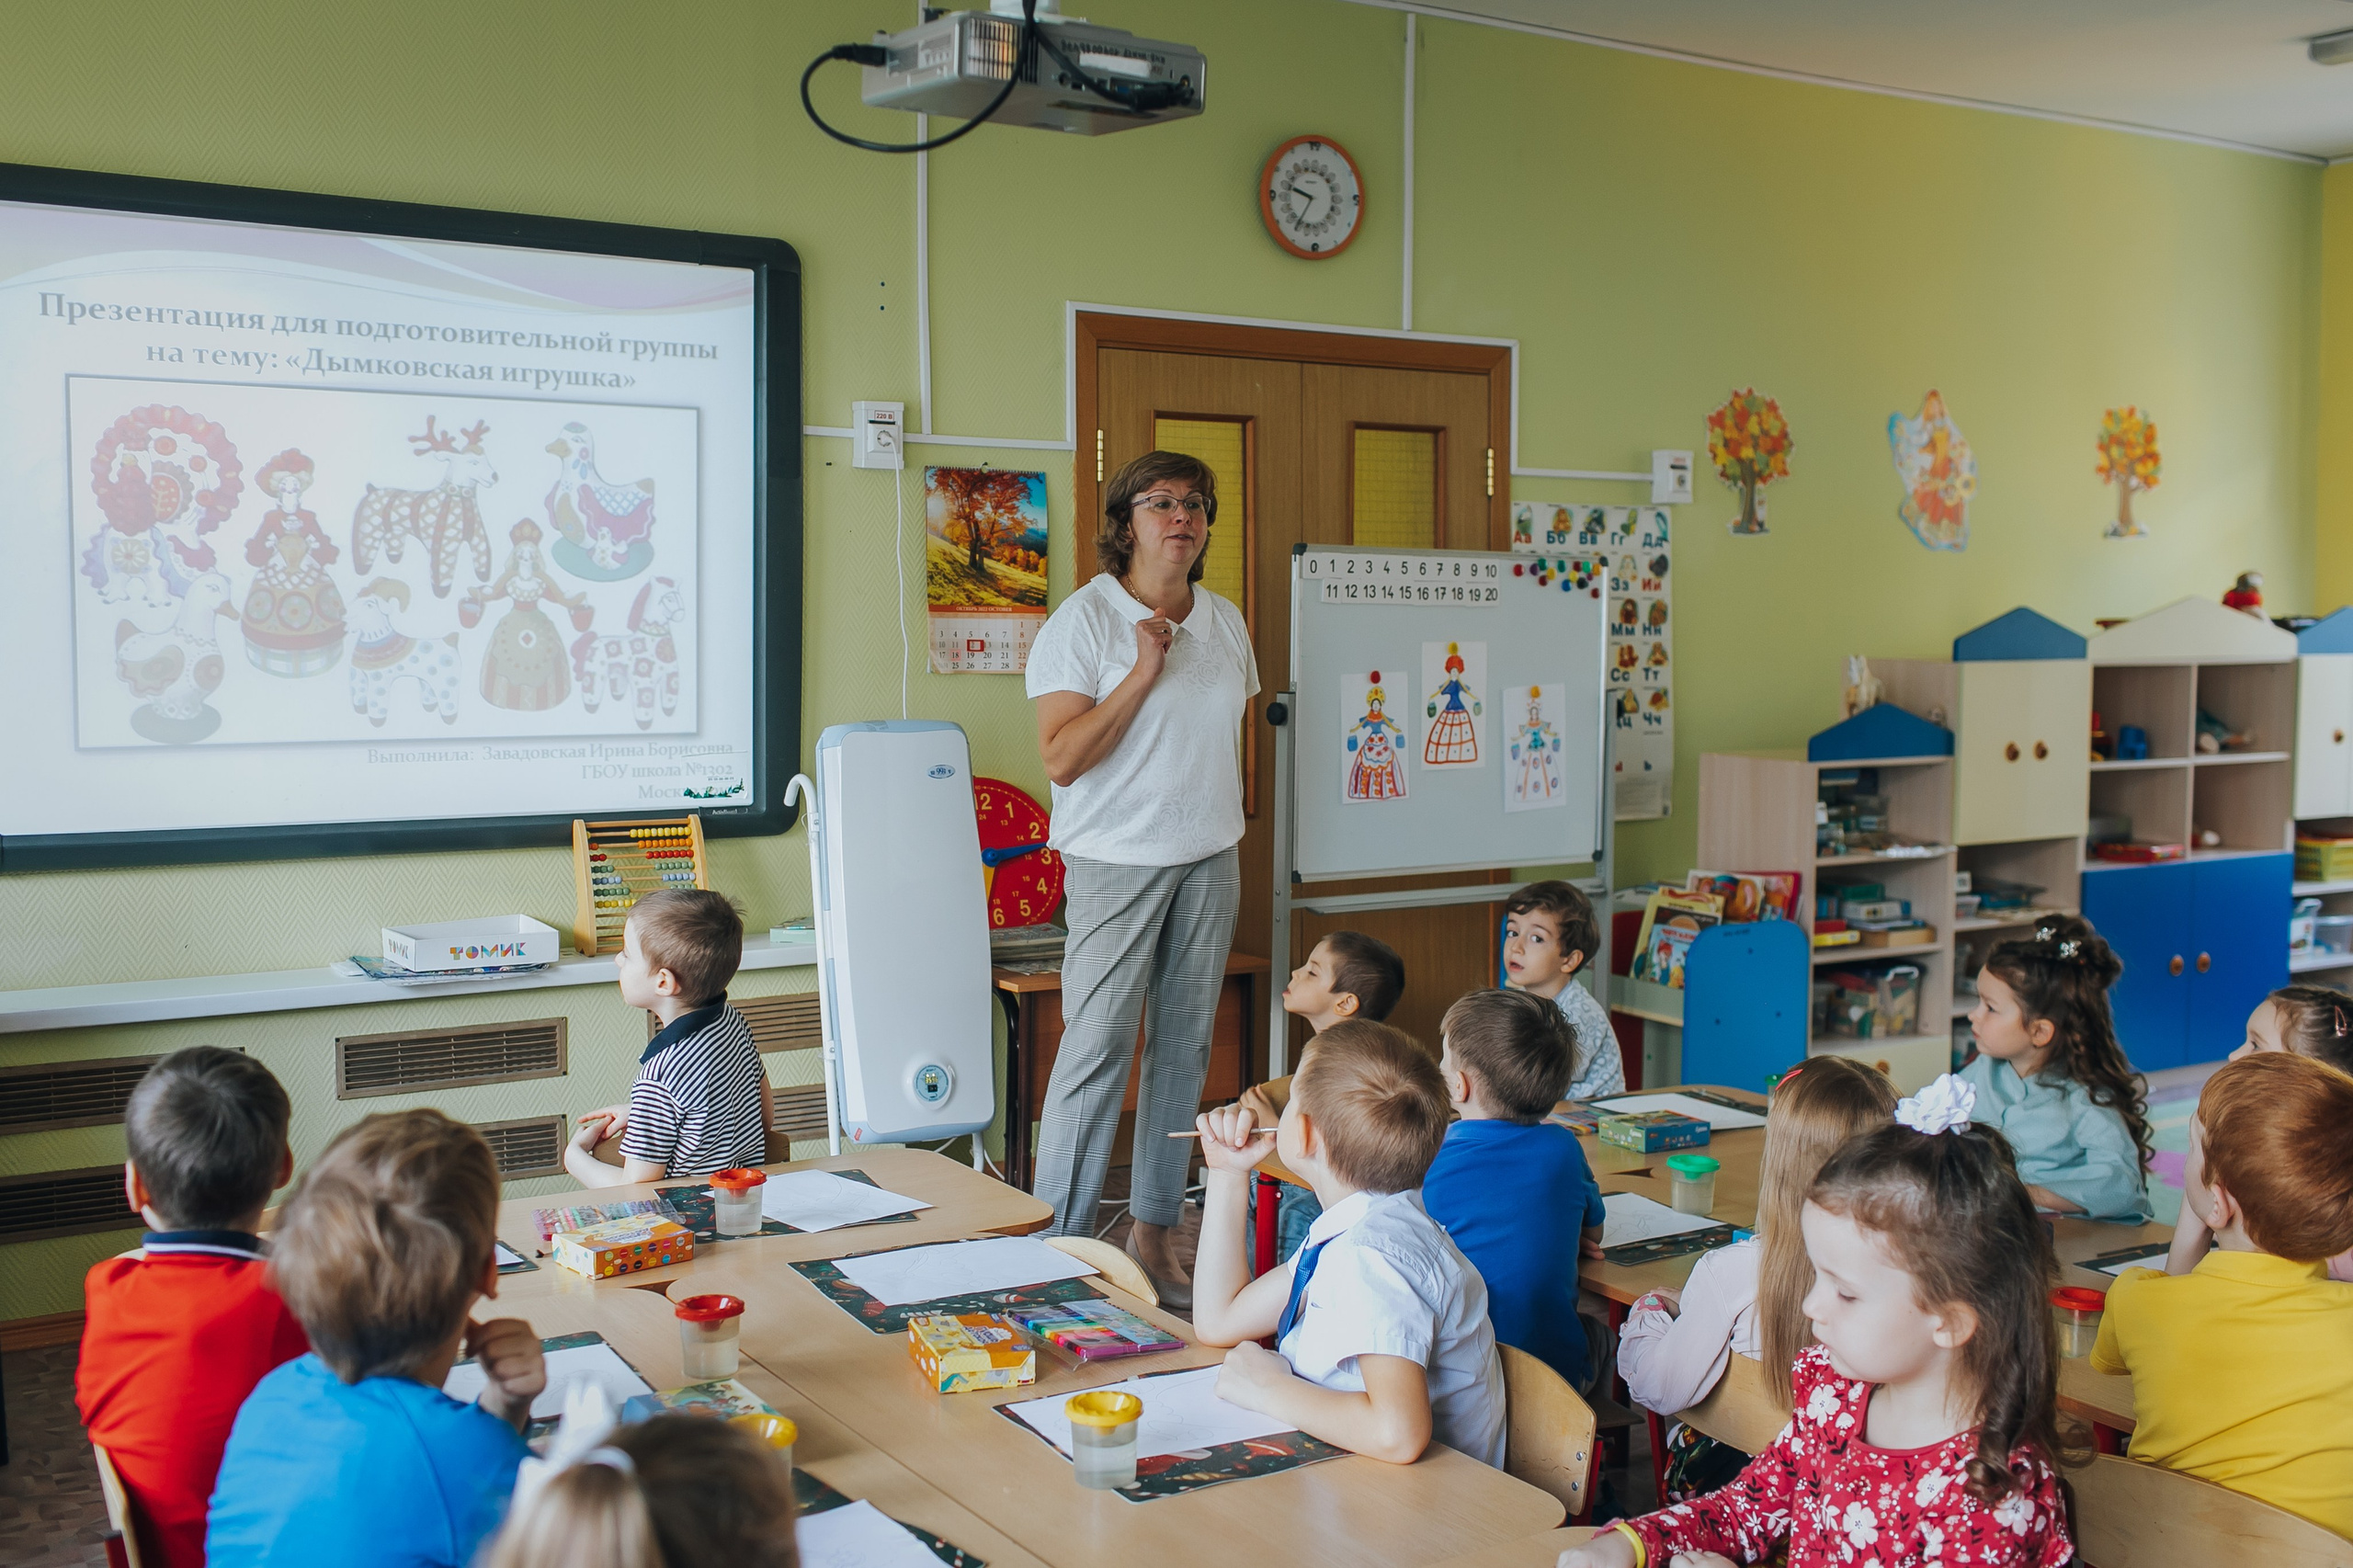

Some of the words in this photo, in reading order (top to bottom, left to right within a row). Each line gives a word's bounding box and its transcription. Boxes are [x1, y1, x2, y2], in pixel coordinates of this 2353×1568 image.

[39, 291, 265, 333] Презентация
[271, 315, 327, 336] для
[335, 319, 613, 353] подготовительной
[620, 338, 719, 362] группы
[146, 345, 184, 364] на
[193, 347, 278, 374] тему:
[286, 347, 495, 382] «Дымковская
[501, 363, 637, 392] игрушка»
[1310, 560, 1317, 574] 0
[1330, 560, 1336, 573] 1
[1347, 560, 1355, 574] 2
[1366, 561, 1373, 574] 3
[1383, 561, 1391, 574] 4
[1401, 562, 1408, 574] 5
[1419, 562, 1427, 575] 6
[1437, 562, 1443, 575] 7
[1453, 563, 1461, 576] 8
[1471, 563, 1478, 577] 9
[1485, 564, 1497, 578] 10
[1326, 585, 1338, 598] 11
[1345, 585, 1358, 597] 12
[1363, 585, 1376, 598] 13
[1381, 585, 1394, 599] 14
[1399, 585, 1412, 599] 15
[1416, 587, 1429, 600] 16
[1435, 587, 1447, 600] 17
[1451, 587, 1464, 600] 18
[1469, 588, 1481, 602] 19
[1485, 588, 1498, 602] 20
[367, 747, 474, 765] Выполнила:
[482, 744, 587, 762] Завадовская
[589, 742, 643, 761] Ирина
[647, 740, 733, 759] Борисовна
[582, 763, 629, 780] ГБОУ
[631, 765, 682, 778] школа
[1005, 801, 1014, 818] 1
[1029, 822, 1041, 839] 2
[1040, 847, 1052, 865] 3
[1037, 877, 1048, 894] 4
[993, 907, 1005, 926] 6
[1019, 899, 1031, 917] 5
[449, 941, 527, 960] ТОМИК
